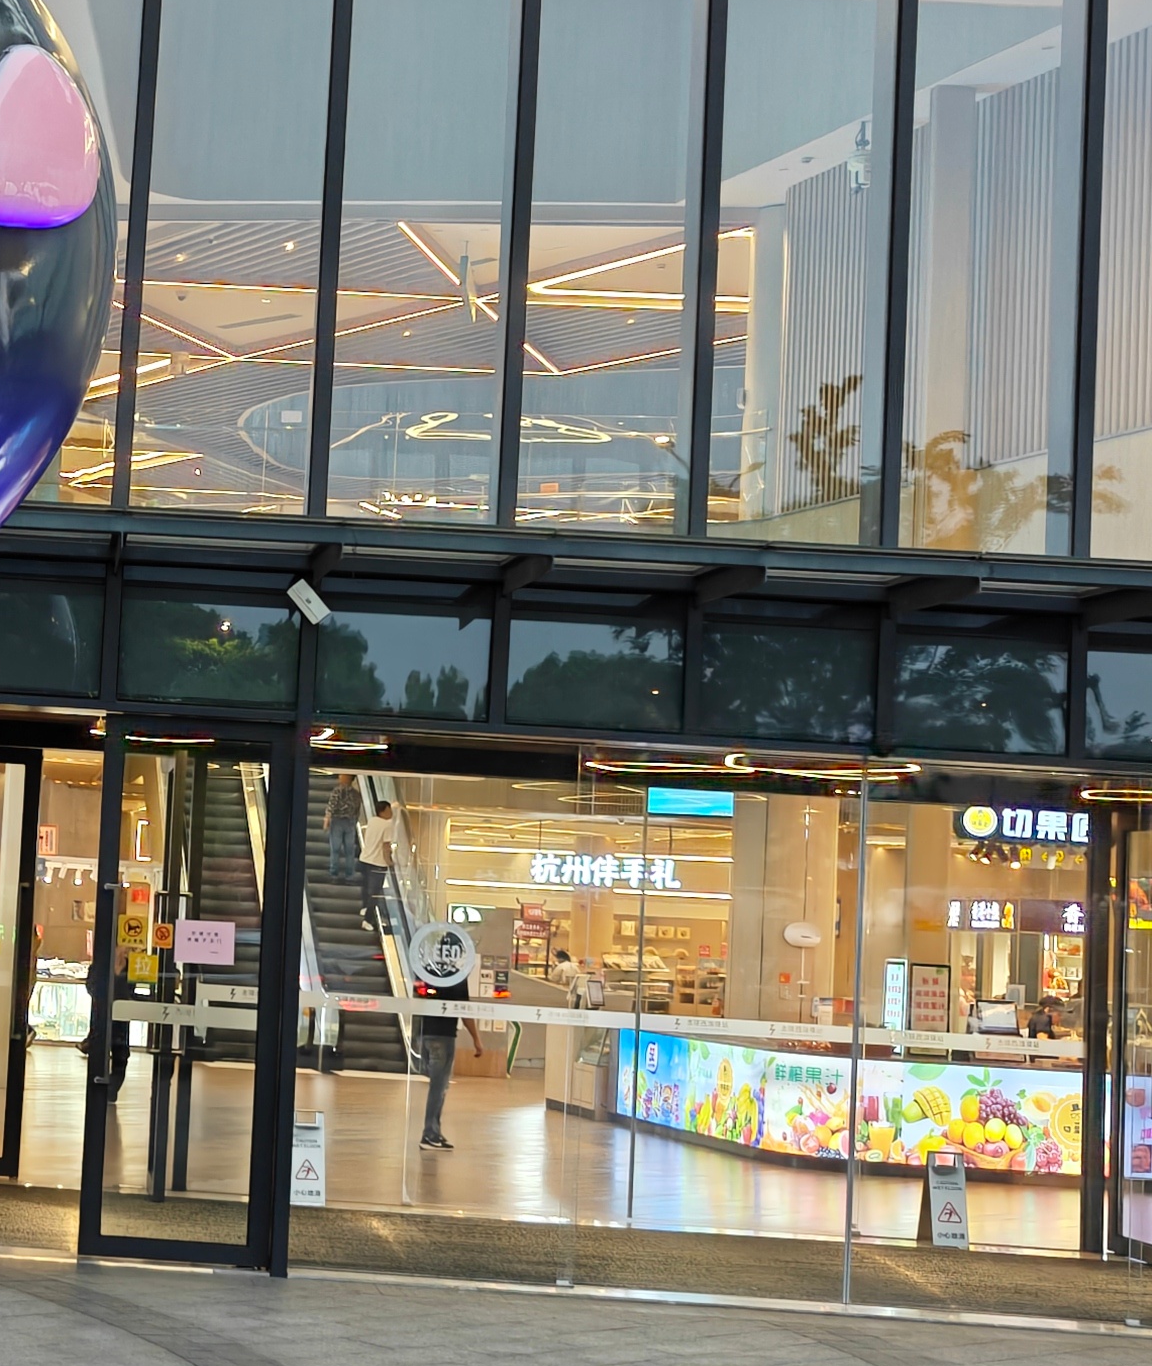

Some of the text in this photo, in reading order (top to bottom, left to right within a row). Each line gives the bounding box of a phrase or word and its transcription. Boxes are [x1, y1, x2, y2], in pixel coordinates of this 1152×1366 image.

[529, 852, 682, 890] 杭州伴手礼
